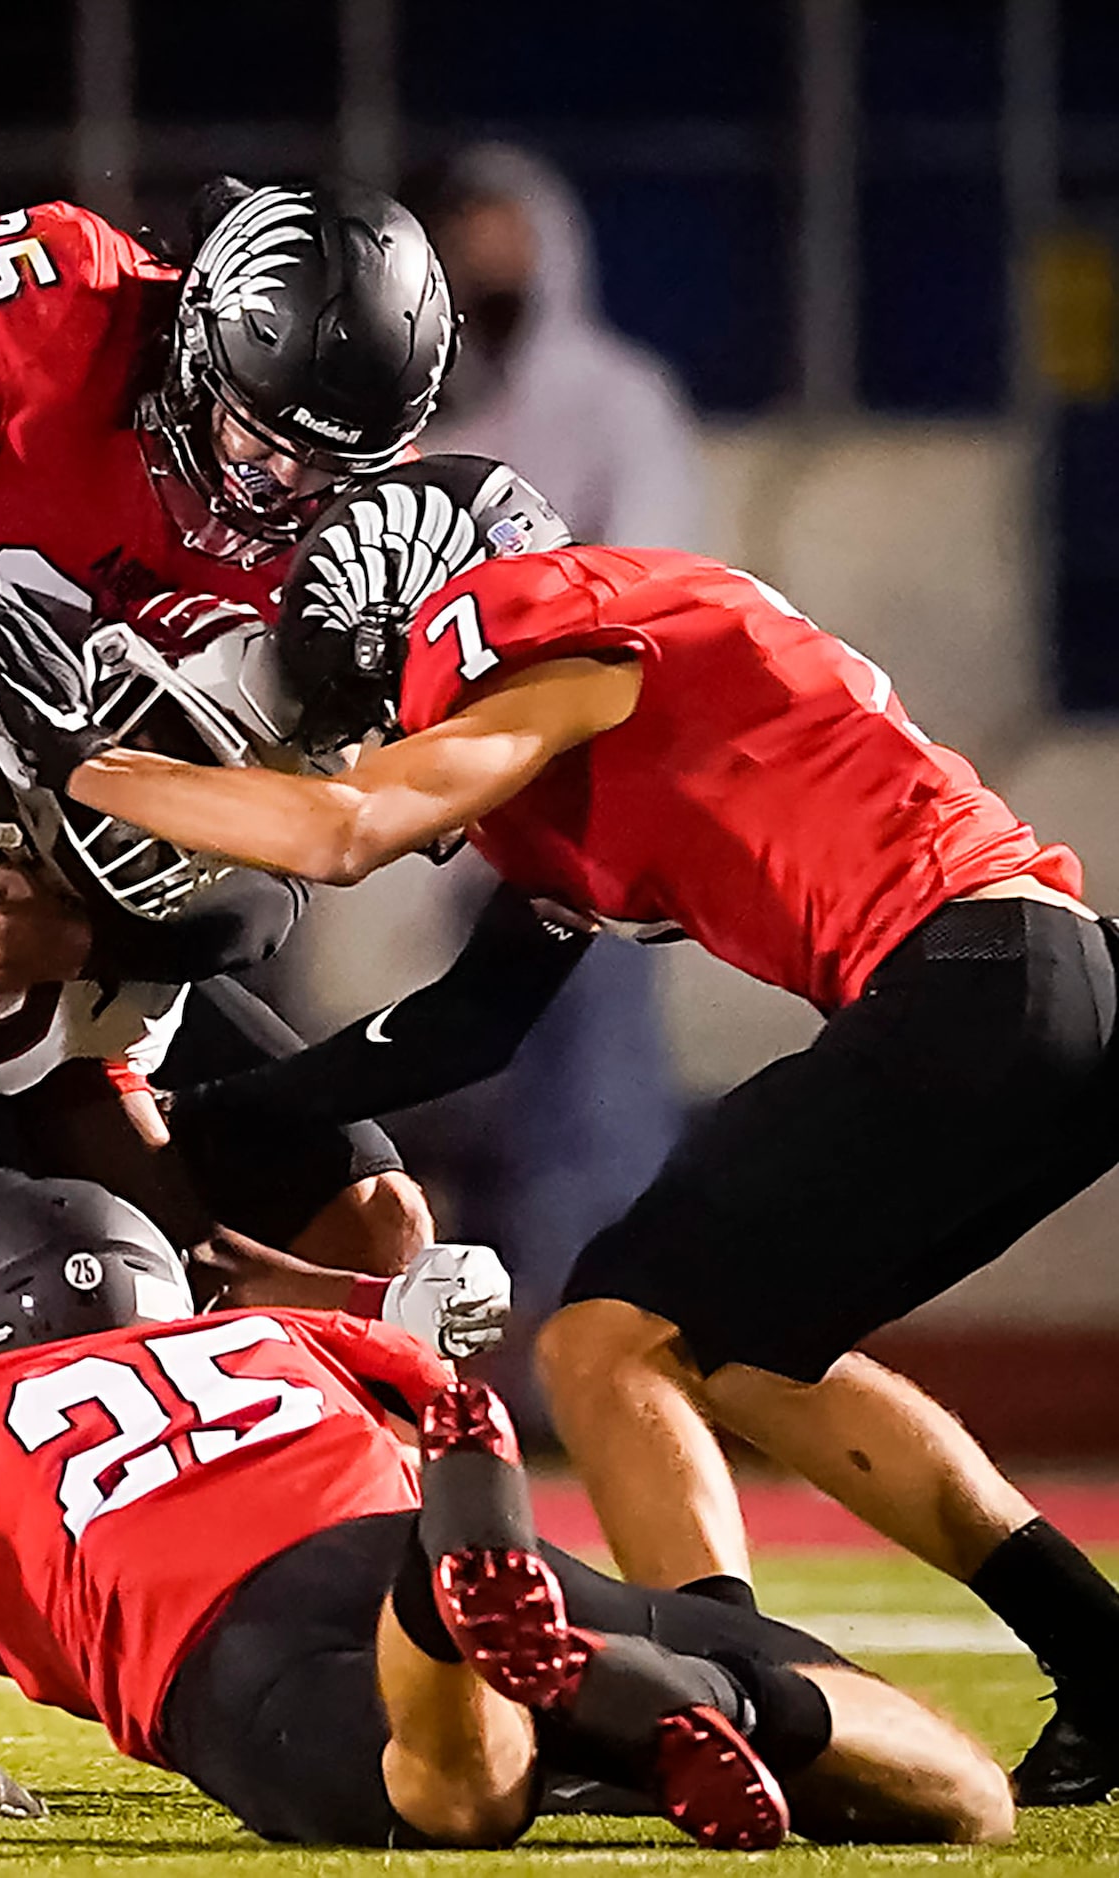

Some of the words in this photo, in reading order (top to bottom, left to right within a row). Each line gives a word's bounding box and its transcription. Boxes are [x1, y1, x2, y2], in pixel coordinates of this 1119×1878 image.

[293, 407, 362, 444] Riddell
[426, 594, 499, 670] 7
[72, 1258, 95, 1284] 25
[6, 1314, 324, 1541] 25
